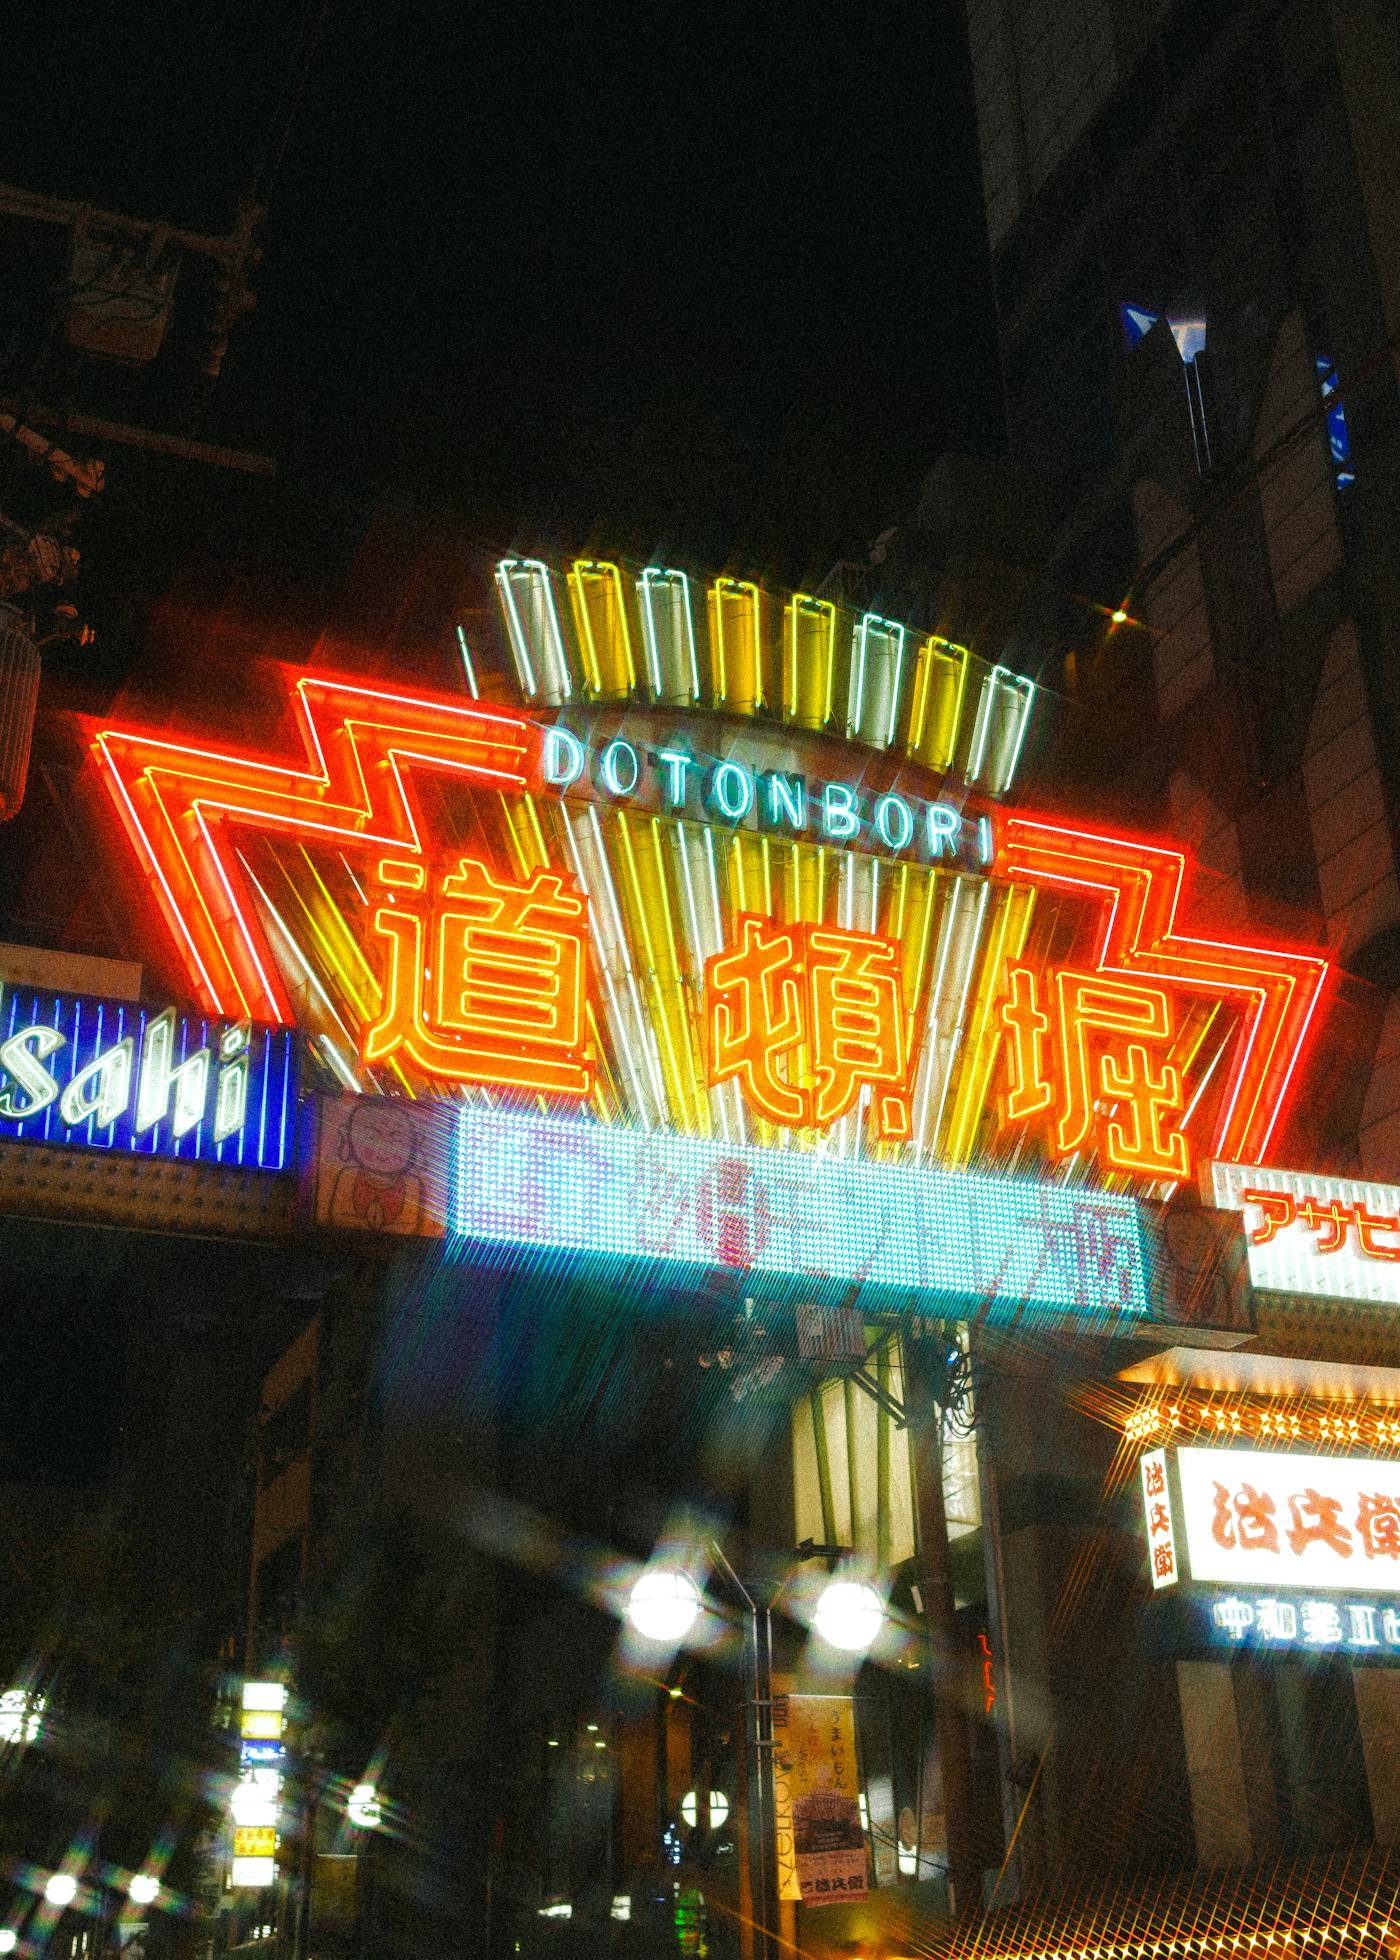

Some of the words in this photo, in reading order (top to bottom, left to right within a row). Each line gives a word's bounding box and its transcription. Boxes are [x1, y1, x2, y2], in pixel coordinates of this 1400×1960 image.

[544, 726, 994, 864] DOTONBORI
[363, 856, 1194, 1180] 道頓堀
[1244, 1188, 1400, 1262] アサヒ
